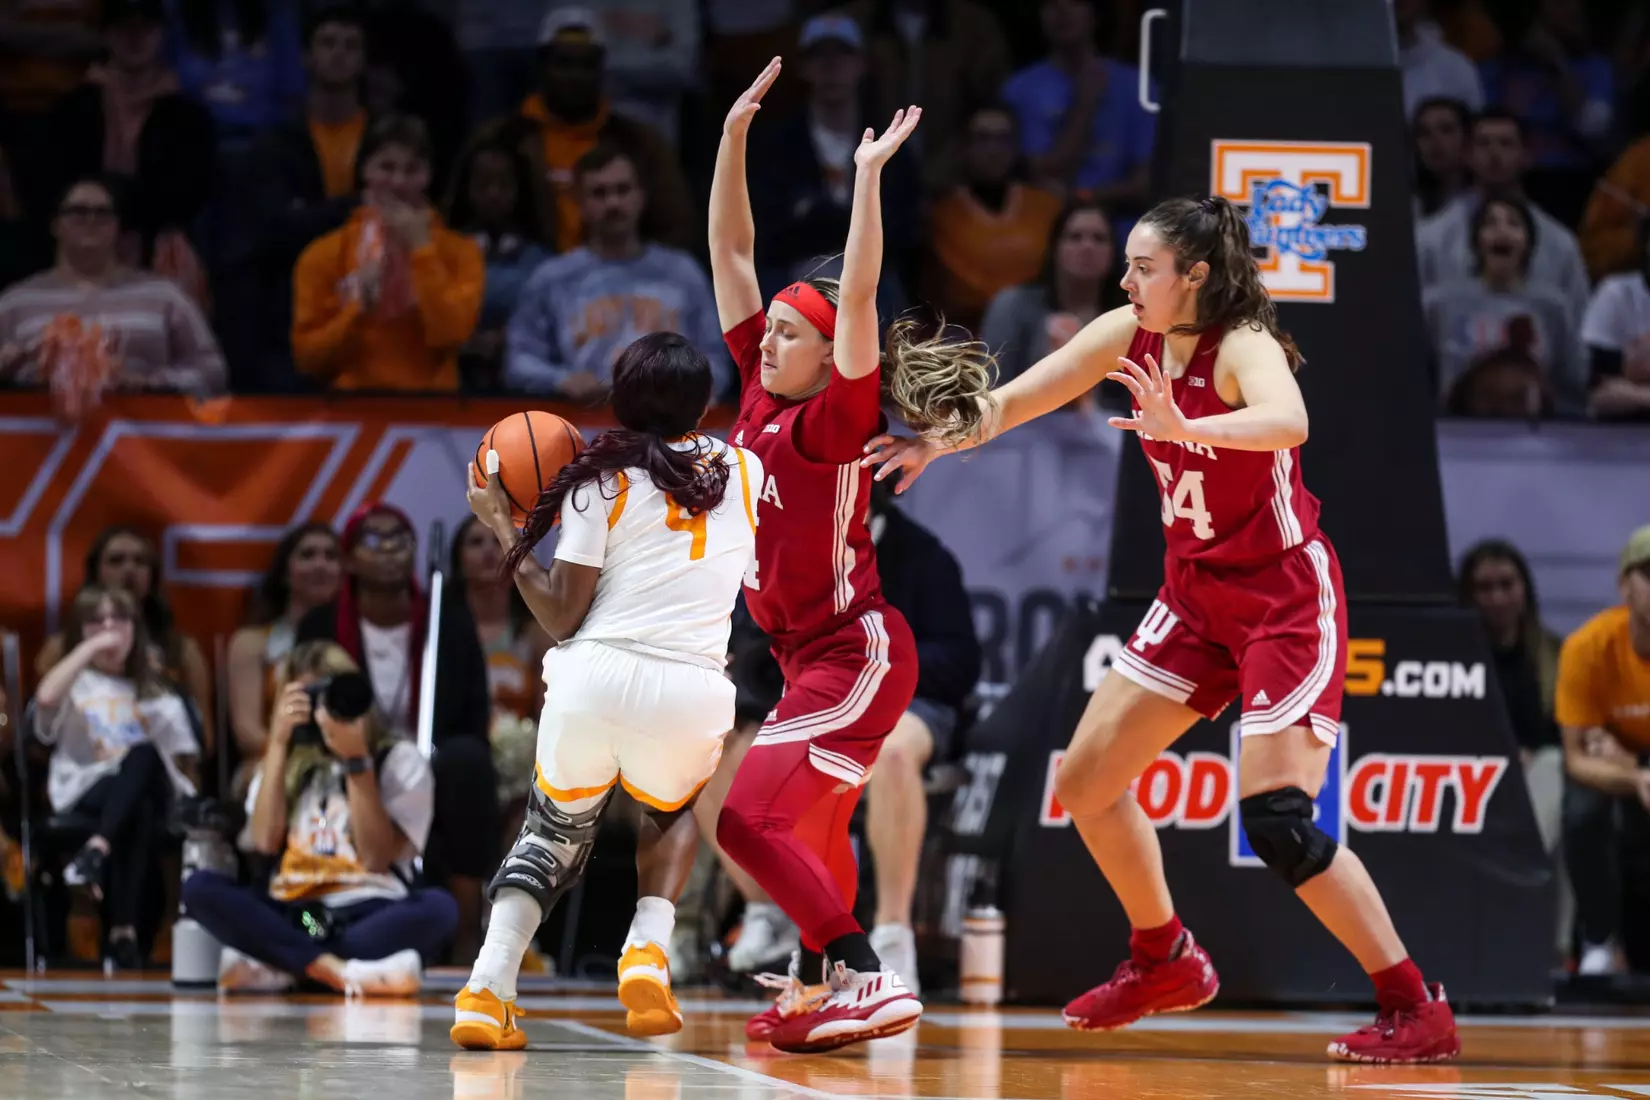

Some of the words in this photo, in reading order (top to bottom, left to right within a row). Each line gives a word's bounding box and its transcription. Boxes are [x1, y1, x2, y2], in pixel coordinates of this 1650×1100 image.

[1211, 139, 1372, 303] T
[1248, 180, 1328, 224] Lady
[1150, 455, 1216, 541] 54
[1345, 752, 1509, 834] CITY
